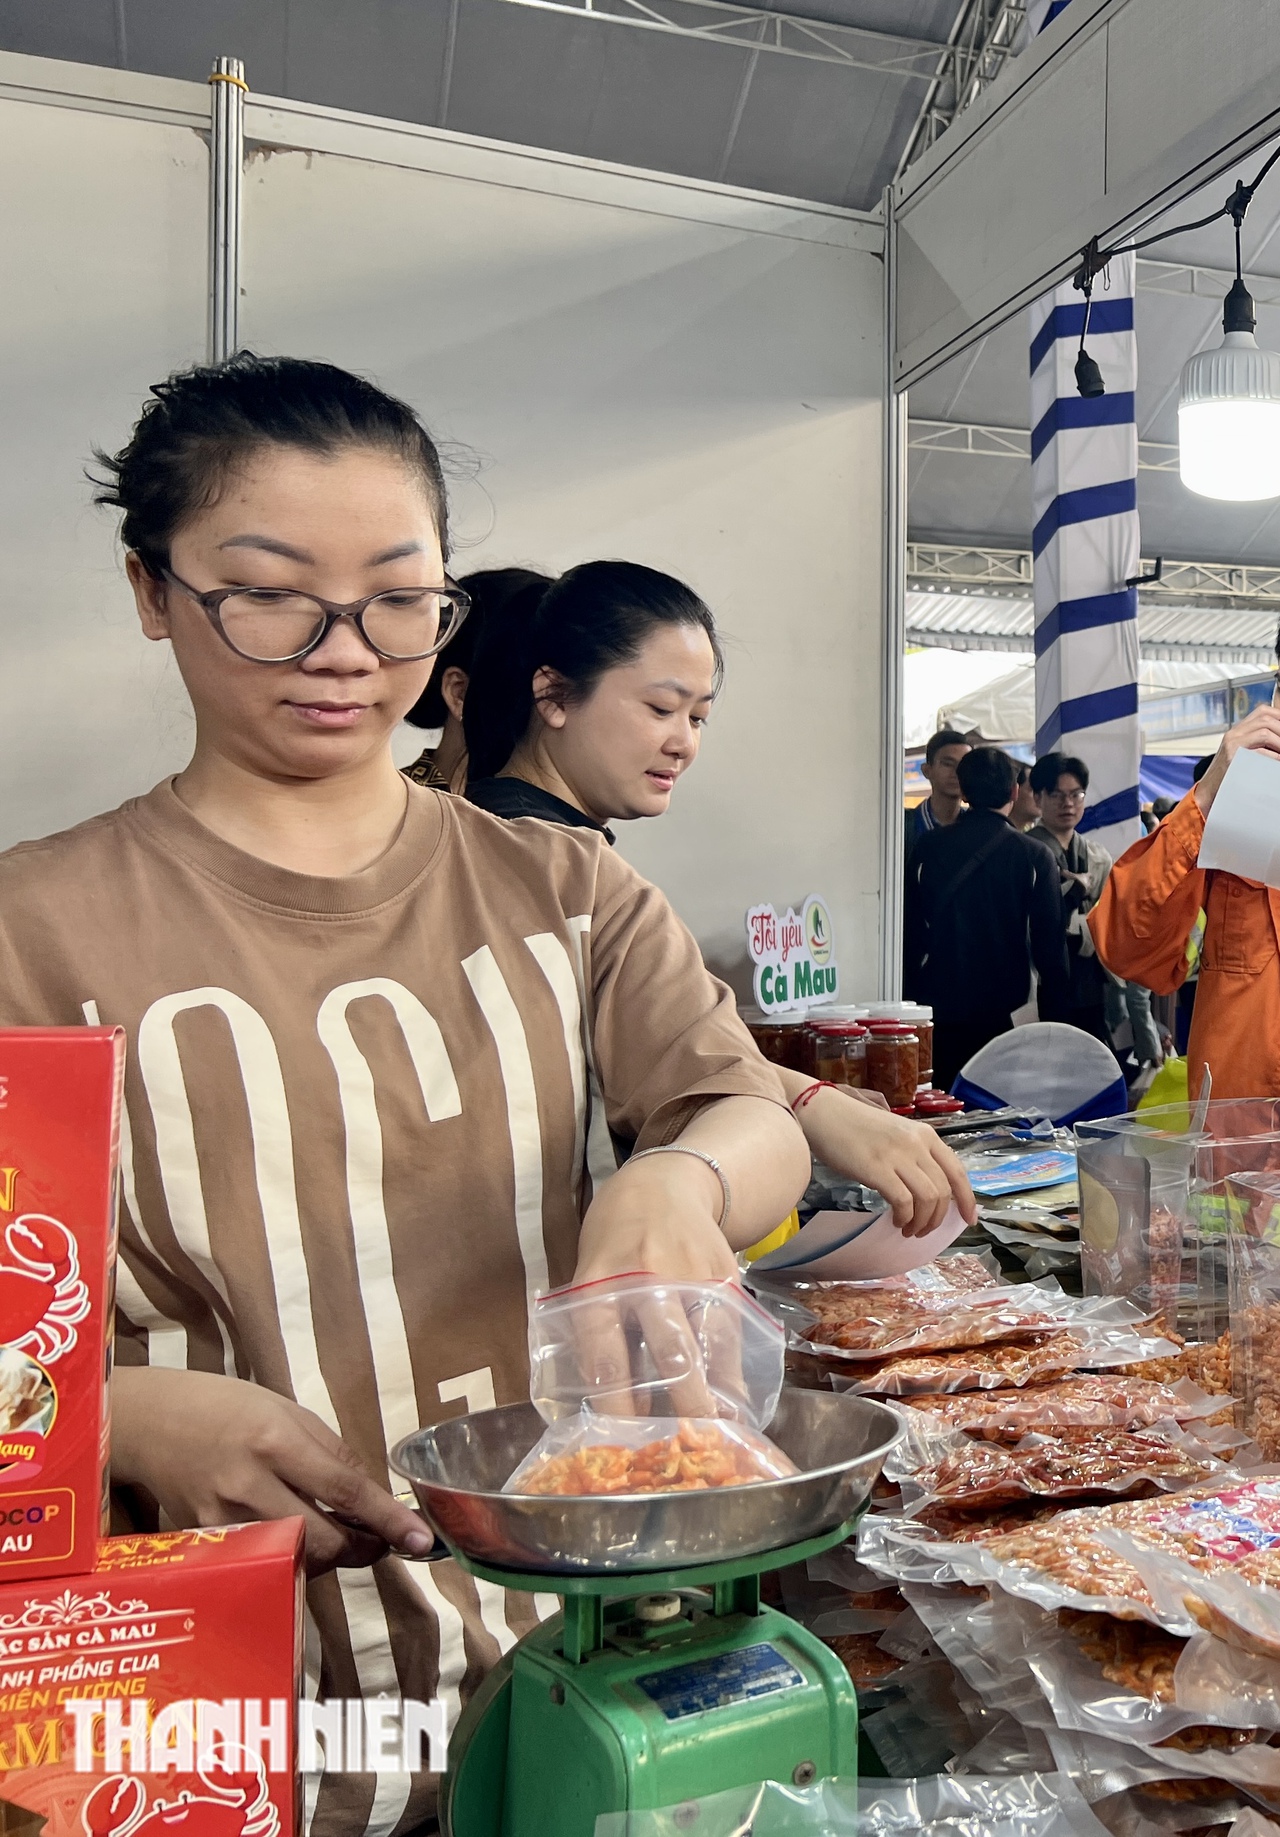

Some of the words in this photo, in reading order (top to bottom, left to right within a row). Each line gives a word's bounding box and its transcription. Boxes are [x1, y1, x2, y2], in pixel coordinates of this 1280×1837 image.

[751, 912, 778, 955] Tôi
[781, 916, 804, 963] yêu
[760, 963, 788, 1005] Cà
[794, 960, 837, 1000] Mau
[0, 1532, 33, 1553] AU
[28, 1631, 71, 1651] SẢN
[76, 1626, 106, 1646] CÀ
[110, 1623, 157, 1642] MAU
[0, 1669, 34, 1690] NH
[38, 1655, 114, 1684] PHỒNG
[118, 1653, 161, 1675] CUA
